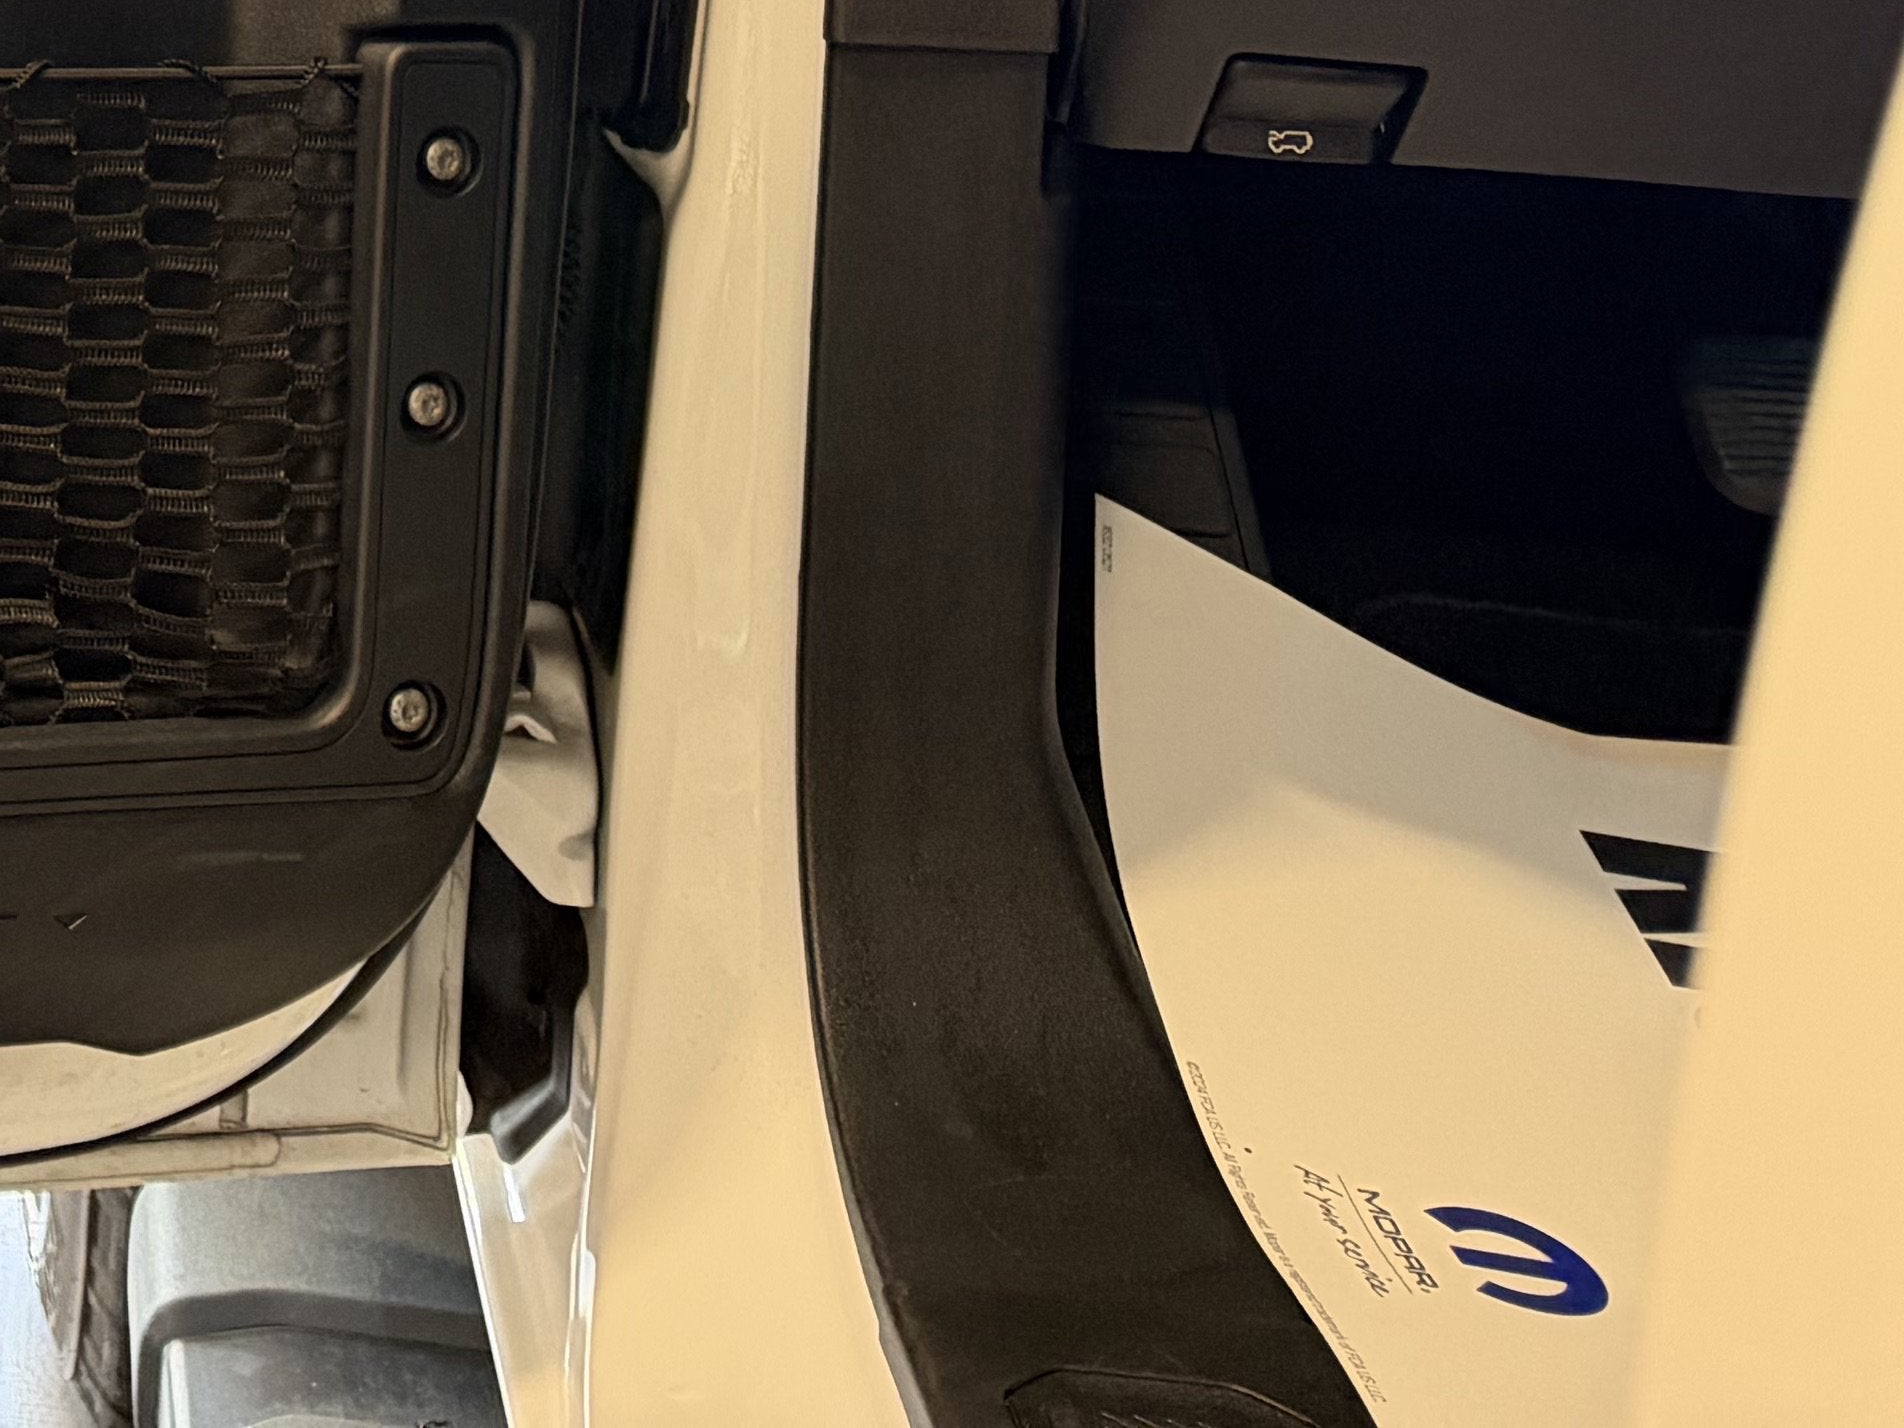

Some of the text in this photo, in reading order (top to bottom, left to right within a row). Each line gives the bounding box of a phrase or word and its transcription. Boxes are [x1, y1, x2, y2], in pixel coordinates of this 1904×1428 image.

[1293, 1164, 1393, 1298] At your service
